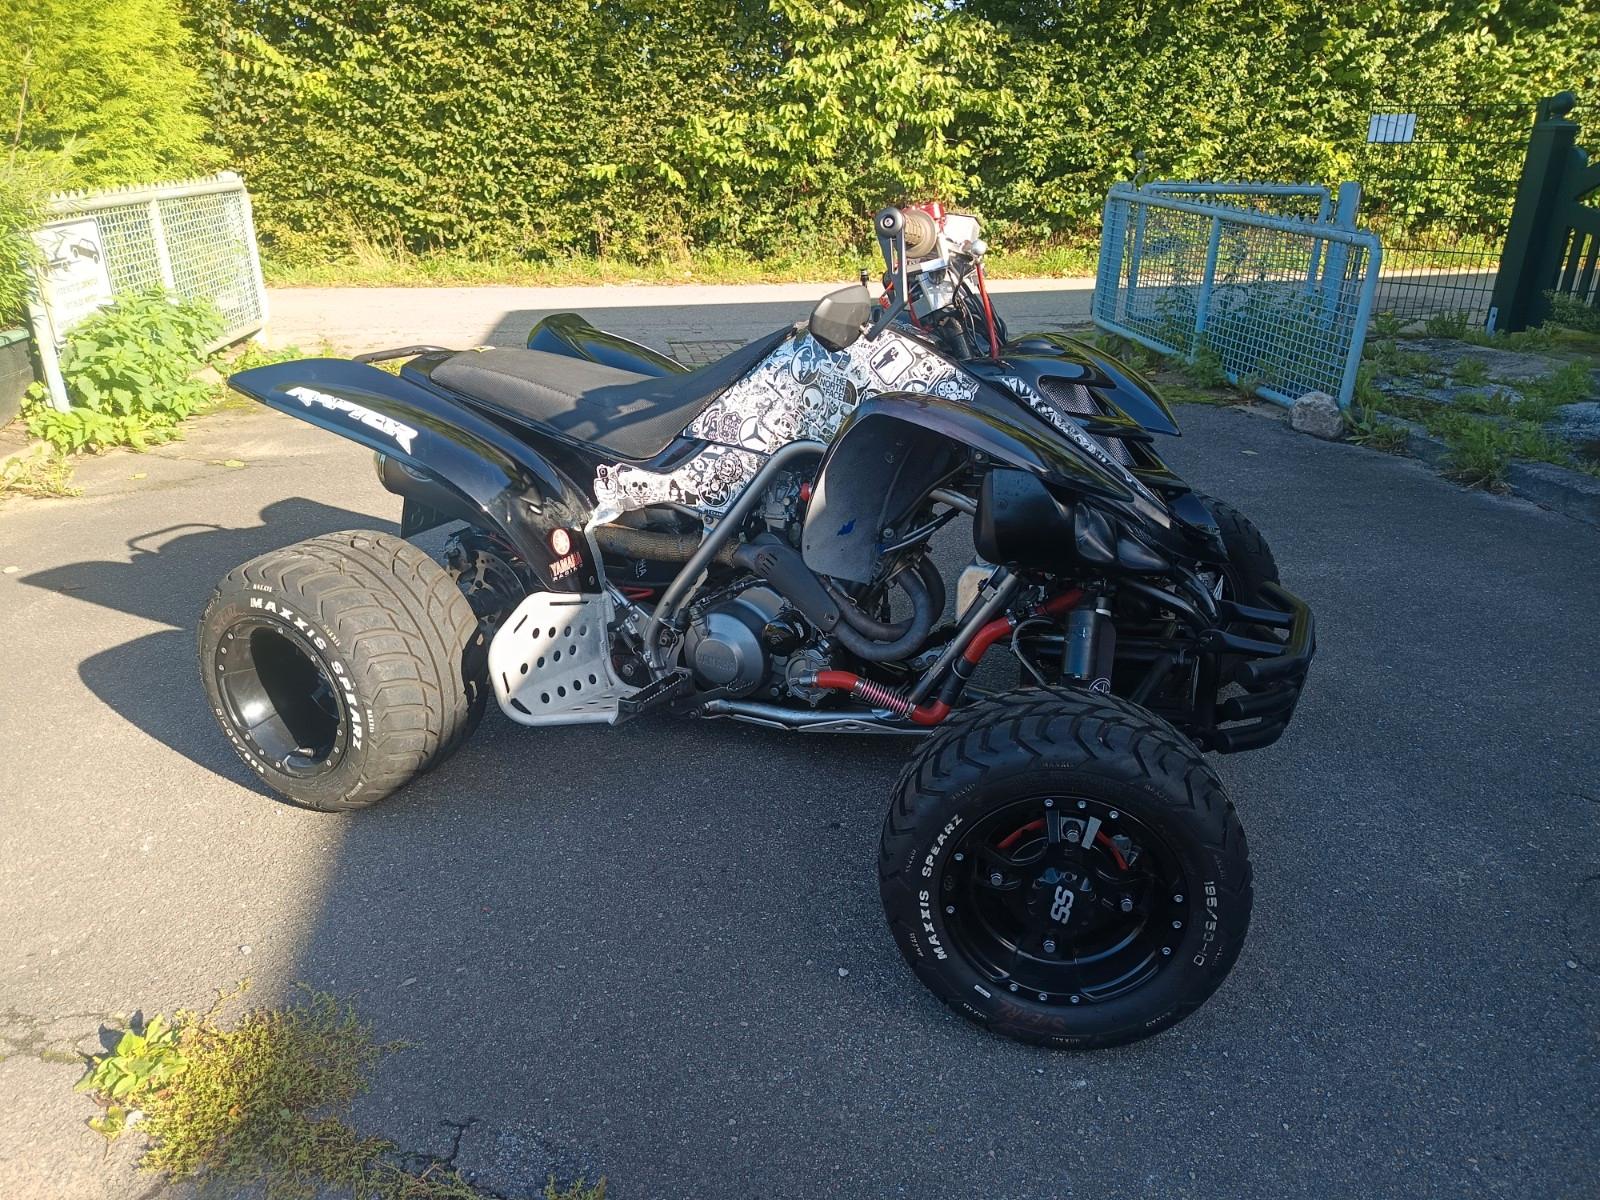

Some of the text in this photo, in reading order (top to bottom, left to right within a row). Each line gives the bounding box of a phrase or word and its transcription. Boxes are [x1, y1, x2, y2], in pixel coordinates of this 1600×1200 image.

[820, 378, 845, 393] NORTH
[833, 374, 846, 385] THE
[825, 388, 844, 402] FACE
[250, 597, 363, 751] MAXXIS SPEARZ
[918, 813, 963, 960] MAXXIS SPEARZ
